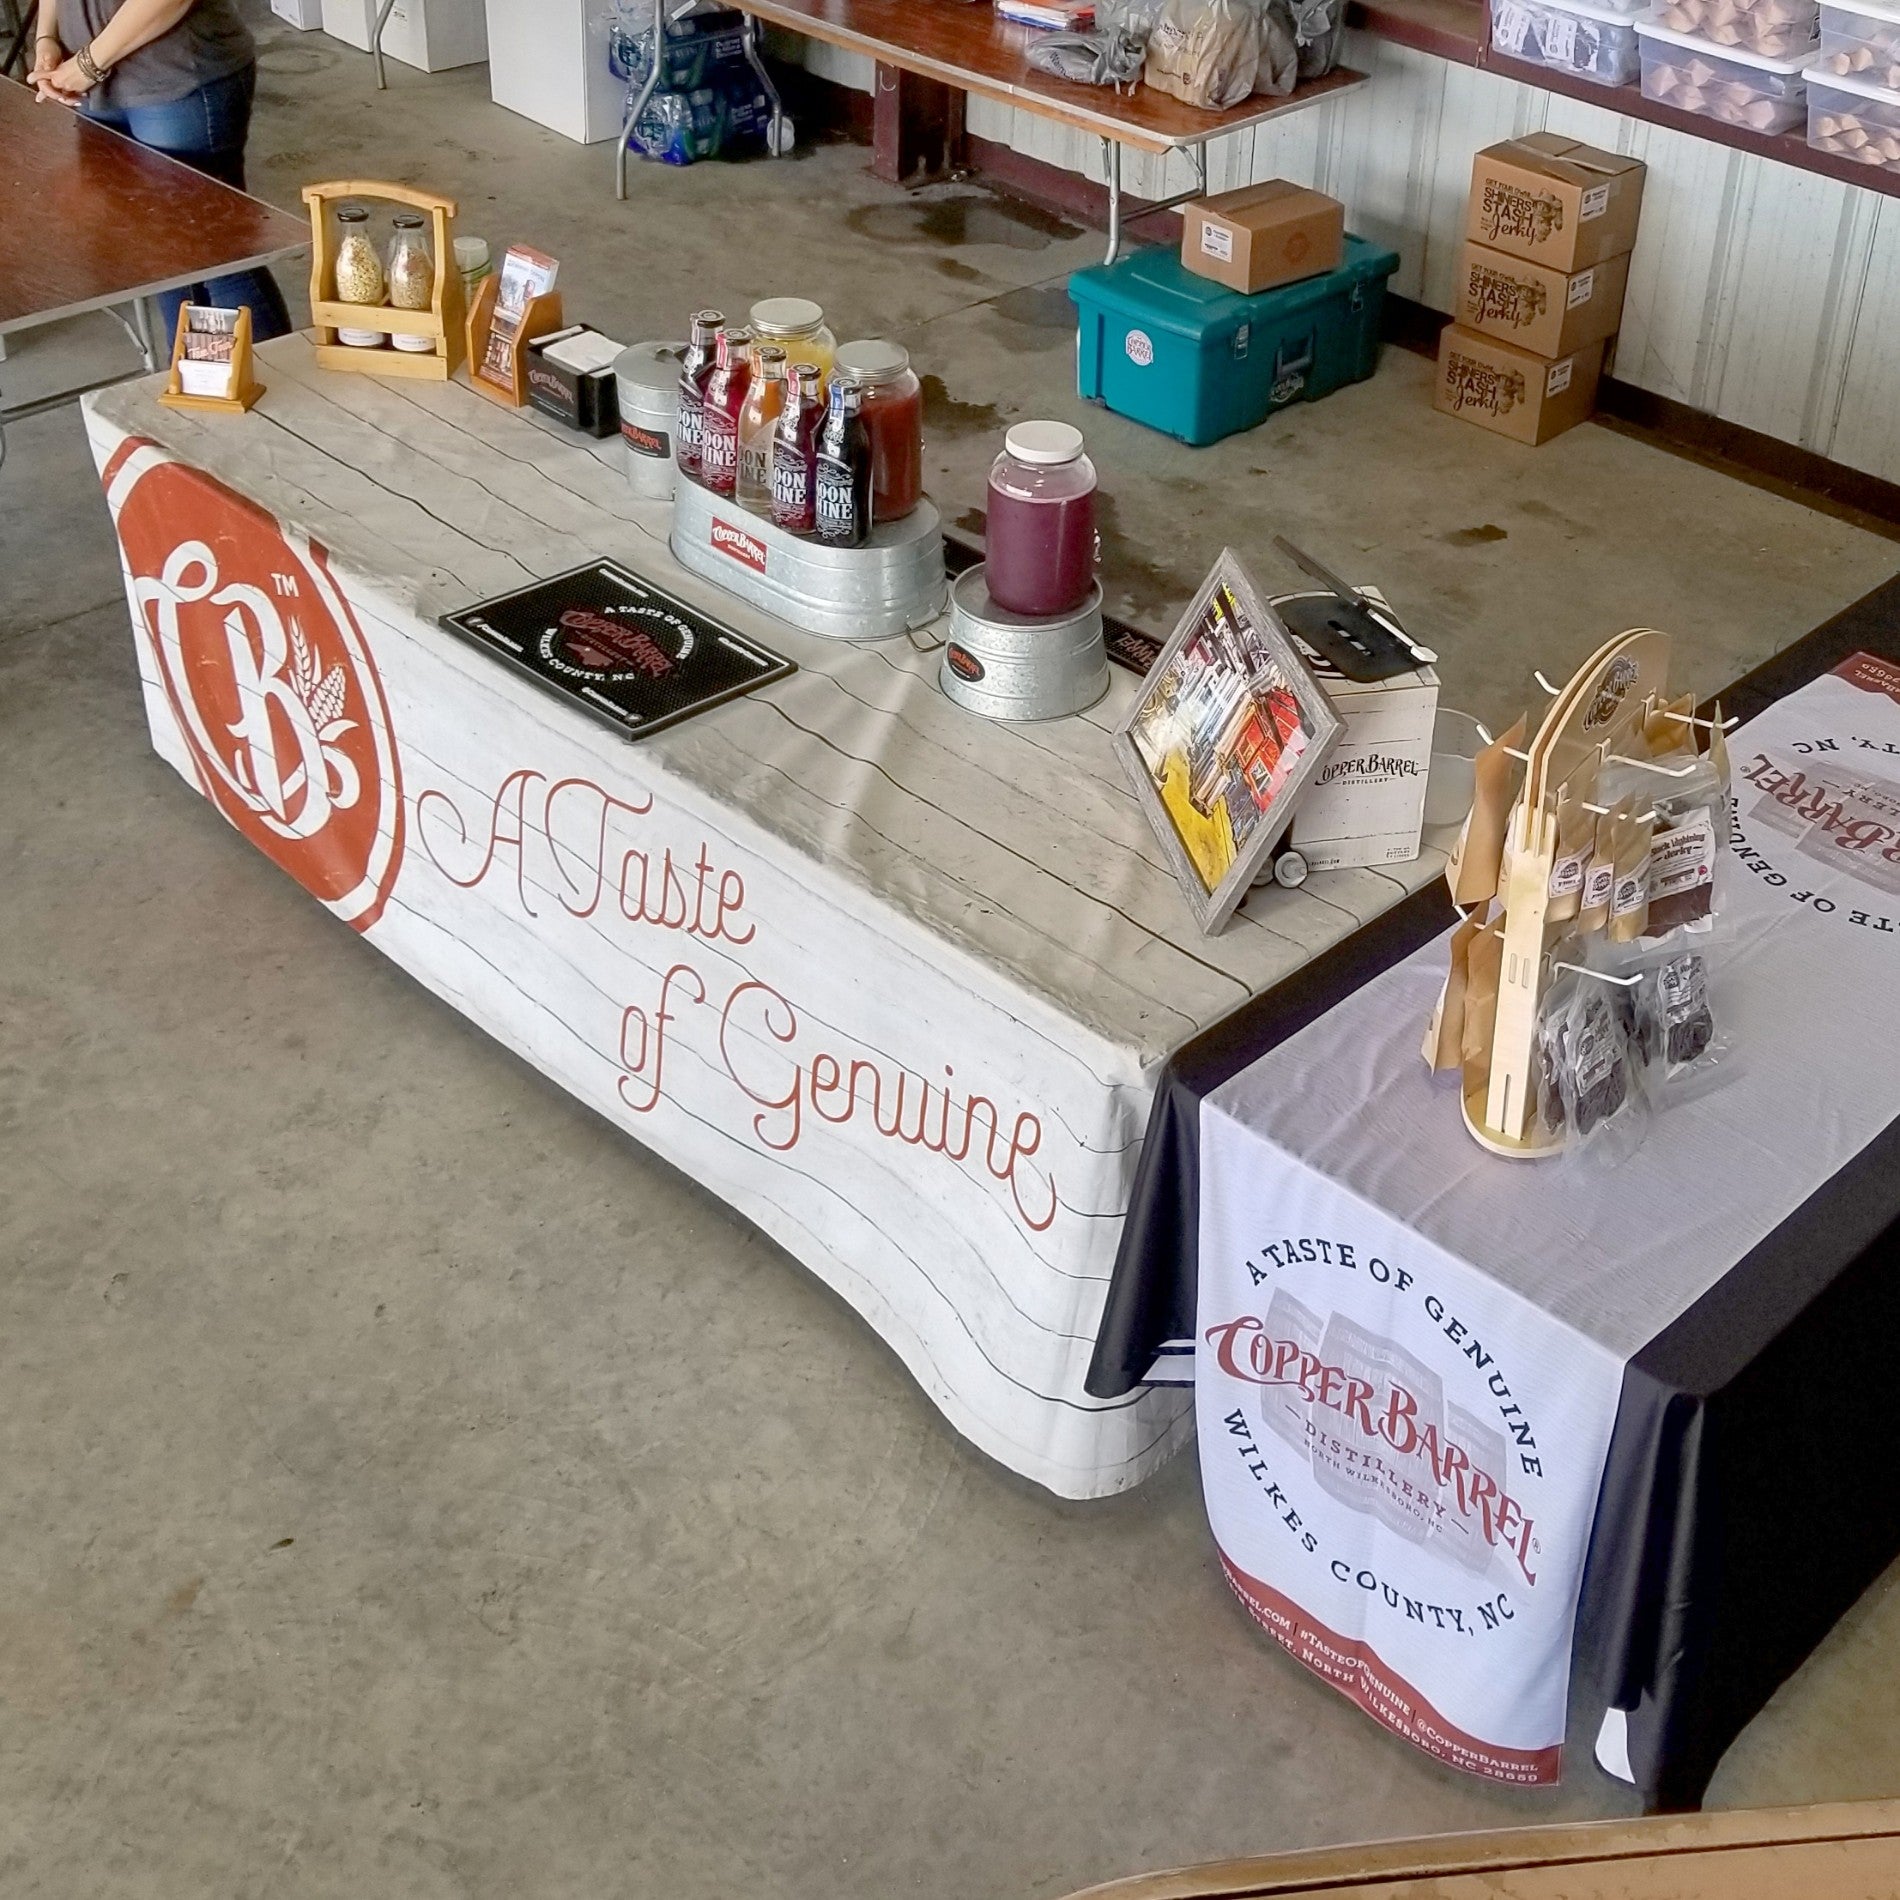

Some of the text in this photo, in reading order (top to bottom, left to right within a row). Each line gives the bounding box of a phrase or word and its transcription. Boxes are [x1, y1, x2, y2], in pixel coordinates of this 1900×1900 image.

[1483, 199, 1534, 228] STASH
[1484, 187, 1532, 212] SHINERS
[1488, 213, 1537, 246] Jerky
[1469, 282, 1518, 312] STASH
[1470, 271, 1516, 297] SHINERS
[1475, 297, 1521, 329] Jerky
[1446, 370, 1496, 400] STASH
[1453, 383, 1500, 417] Jerky
[704, 429, 736, 451] OON
[702, 444, 736, 467] HINE
[773, 467, 806, 490] OON
[816, 481, 853, 504] OON
[773, 485, 806, 505] HINE
[816, 501, 853, 520] HINE
[271, 573, 299, 597] TM
[604, 606, 616, 614] A
[619, 605, 664, 618] TASTE
[664, 615, 682, 626] OF
[612, 672, 635, 681] NC
[1792, 738, 1840, 754] NC
[1365, 753, 1419, 778] BARREL
[1742, 754, 1895, 854] BARREL
[416, 769, 756, 946] A Taste
[1790, 890, 1836, 914] OF
[616, 963, 1057, 1231] of Genuine
[1246, 1238, 1544, 1479] A TASTE OF GENUINE
[1205, 1315, 1538, 1587] COPPER BARREL
[1304, 1419, 1447, 1519] DISTILLERY
[1223, 1408, 1318, 1553] WILKES
[1330, 1559, 1474, 1637] COUNTY,
[1478, 1593, 1515, 1630] NC
[1302, 1648, 1355, 1683] NORTH
[1451, 1754, 1477, 1771] NC
[1416, 1717, 1539, 1772] @COPPERBARREL
